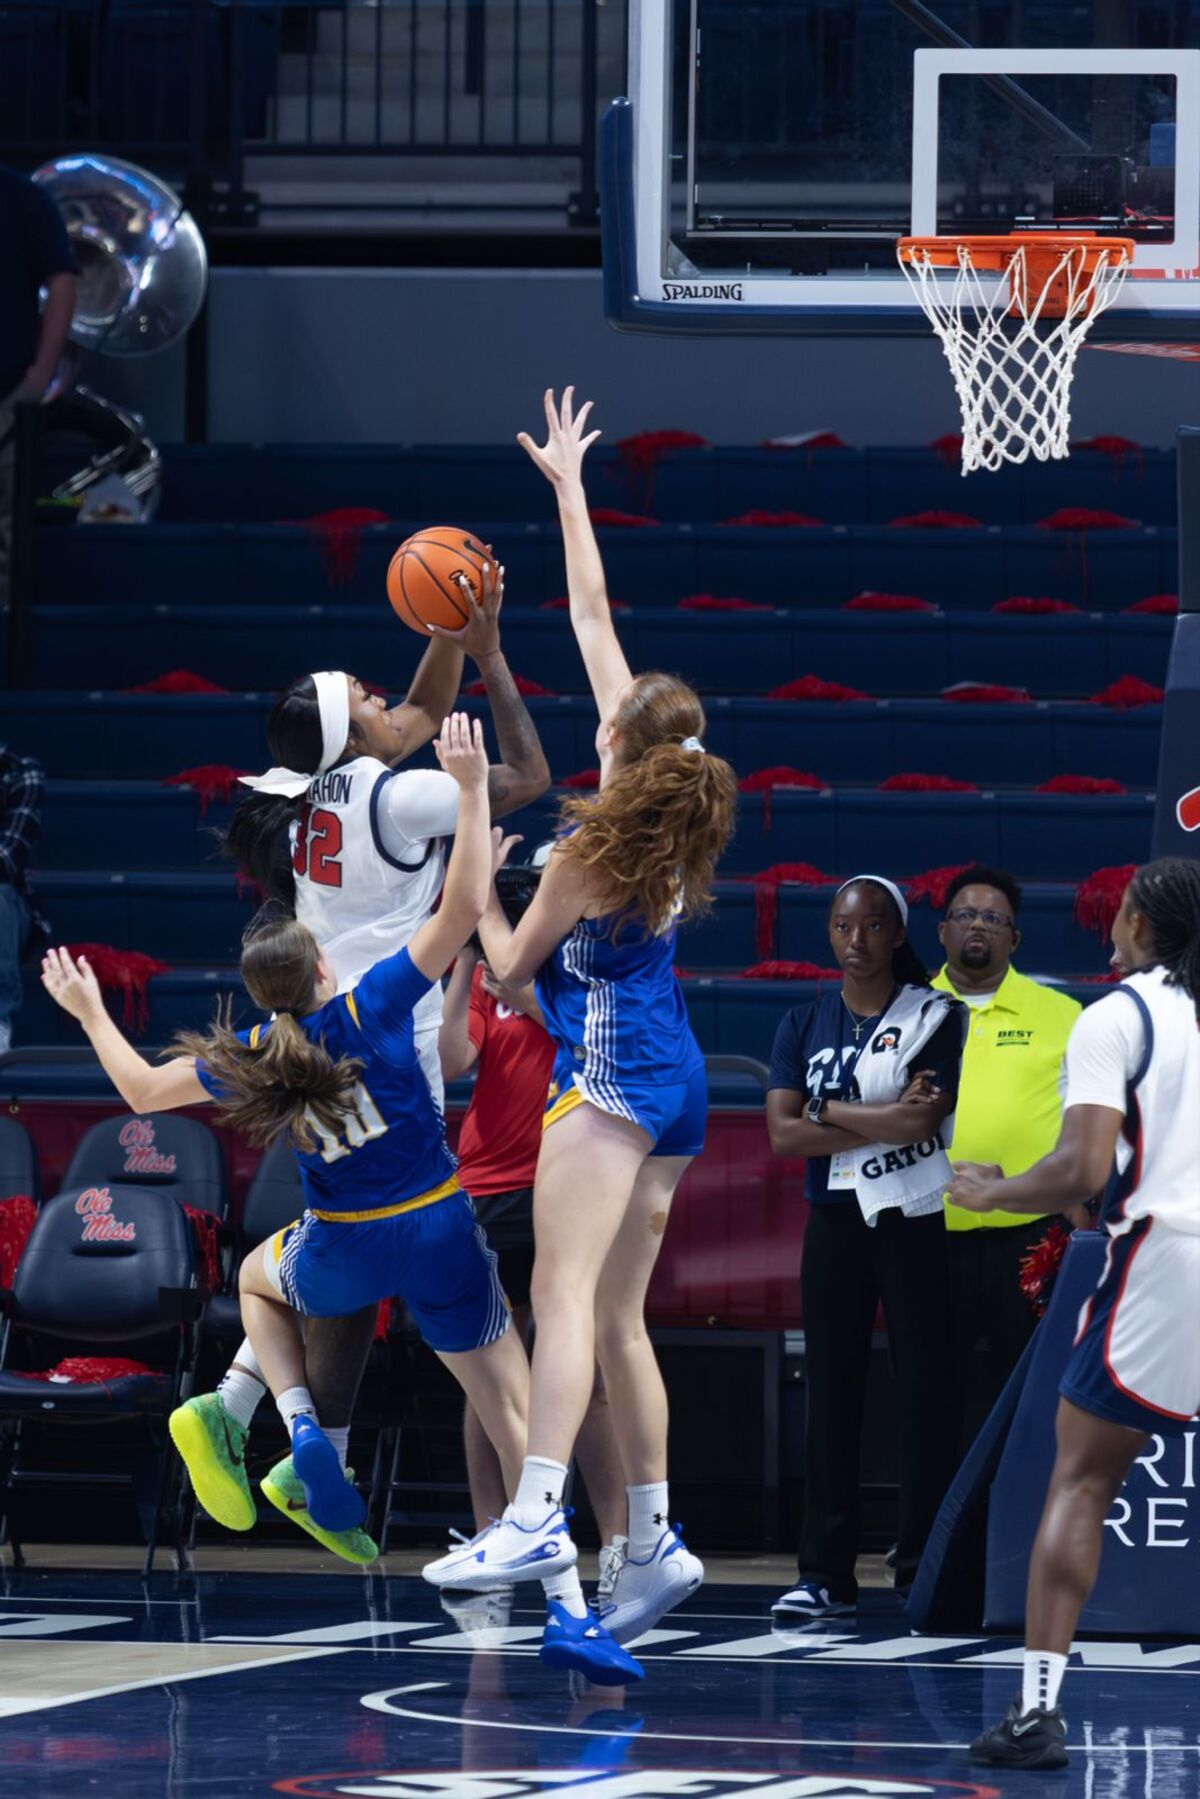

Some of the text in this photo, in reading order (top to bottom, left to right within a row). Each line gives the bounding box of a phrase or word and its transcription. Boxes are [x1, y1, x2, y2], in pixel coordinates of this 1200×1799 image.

[662, 283, 743, 301] SPALDING
[998, 1030, 1034, 1038] BEST
[118, 1119, 155, 1146] Ole
[124, 1145, 176, 1174] Miss
[75, 1187, 113, 1215] Ole
[81, 1213, 136, 1241] Miss
